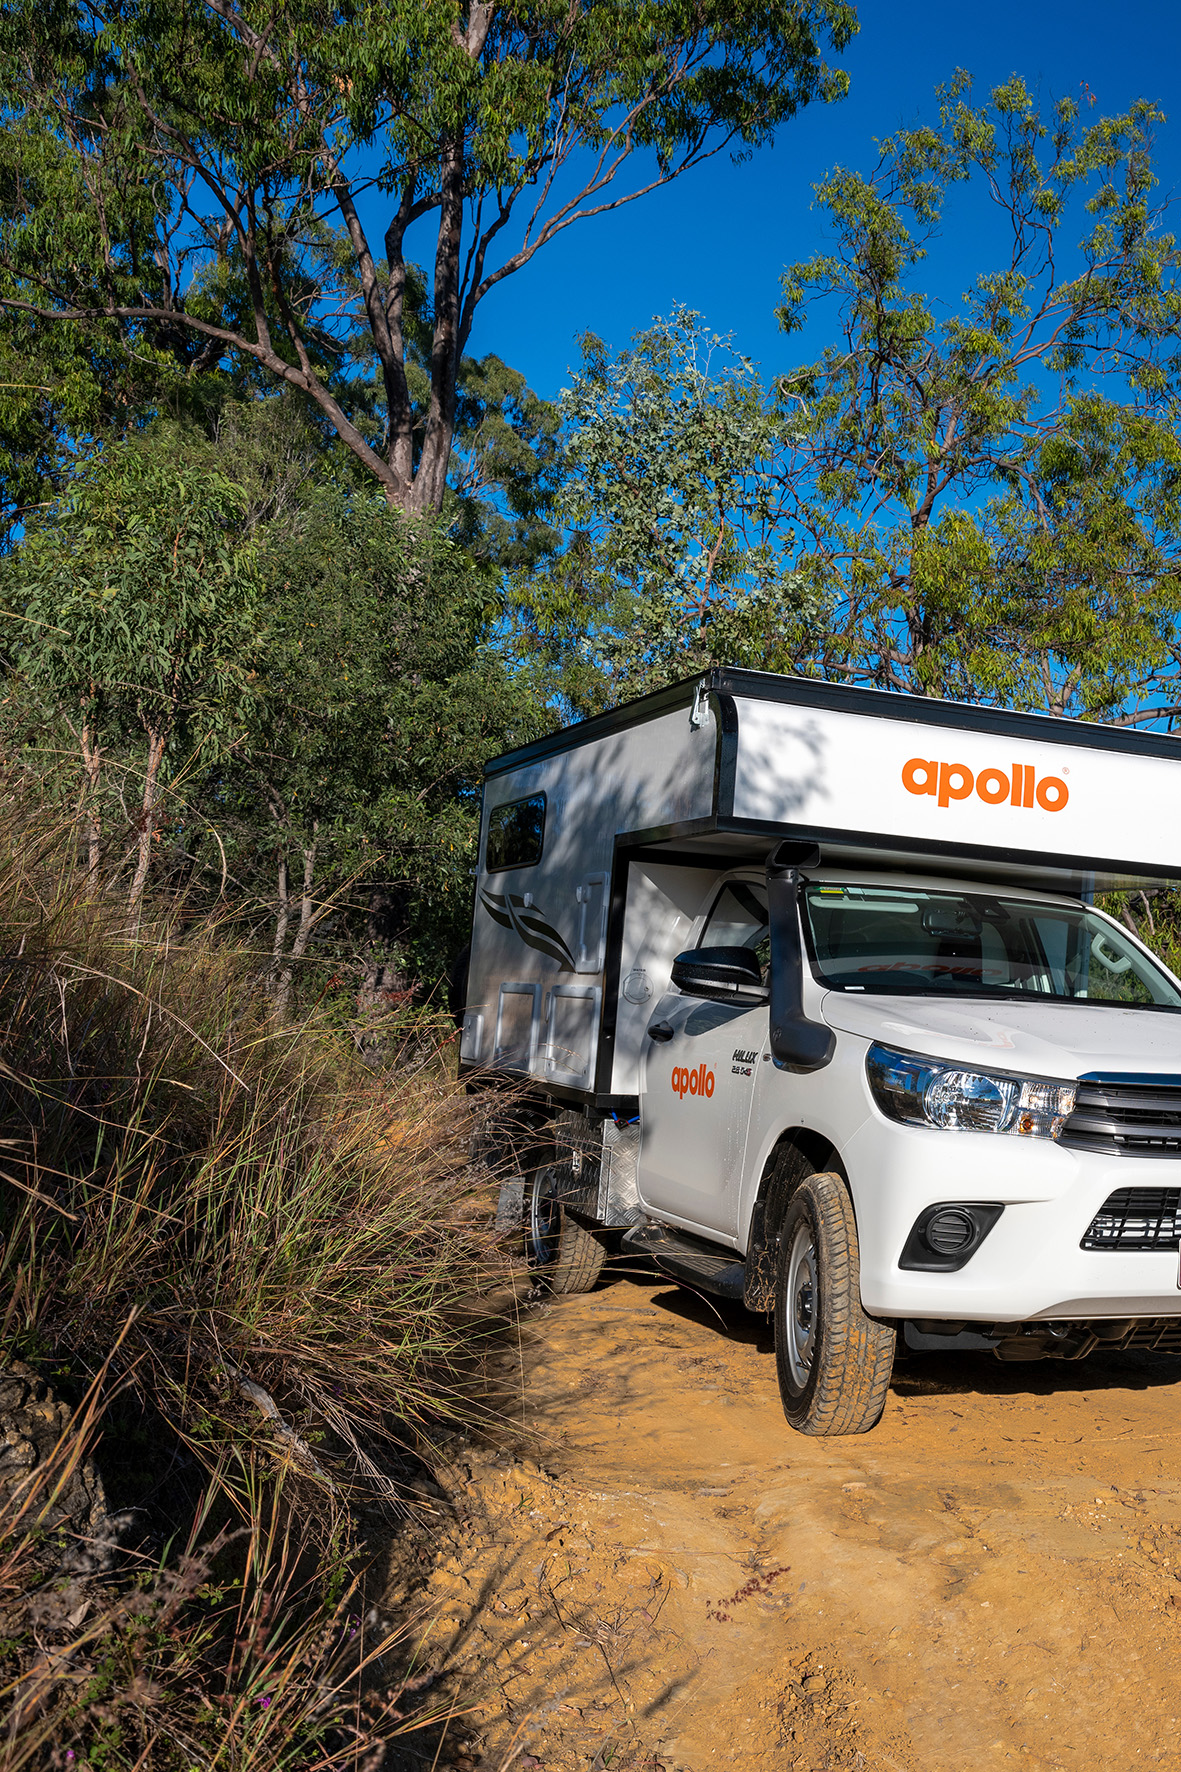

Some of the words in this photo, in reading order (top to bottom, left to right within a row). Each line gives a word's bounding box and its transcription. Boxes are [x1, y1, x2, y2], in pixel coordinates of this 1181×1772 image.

[901, 758, 1069, 812] apollo
[732, 1049, 758, 1064] HILUX
[671, 1063, 715, 1100] apollo
